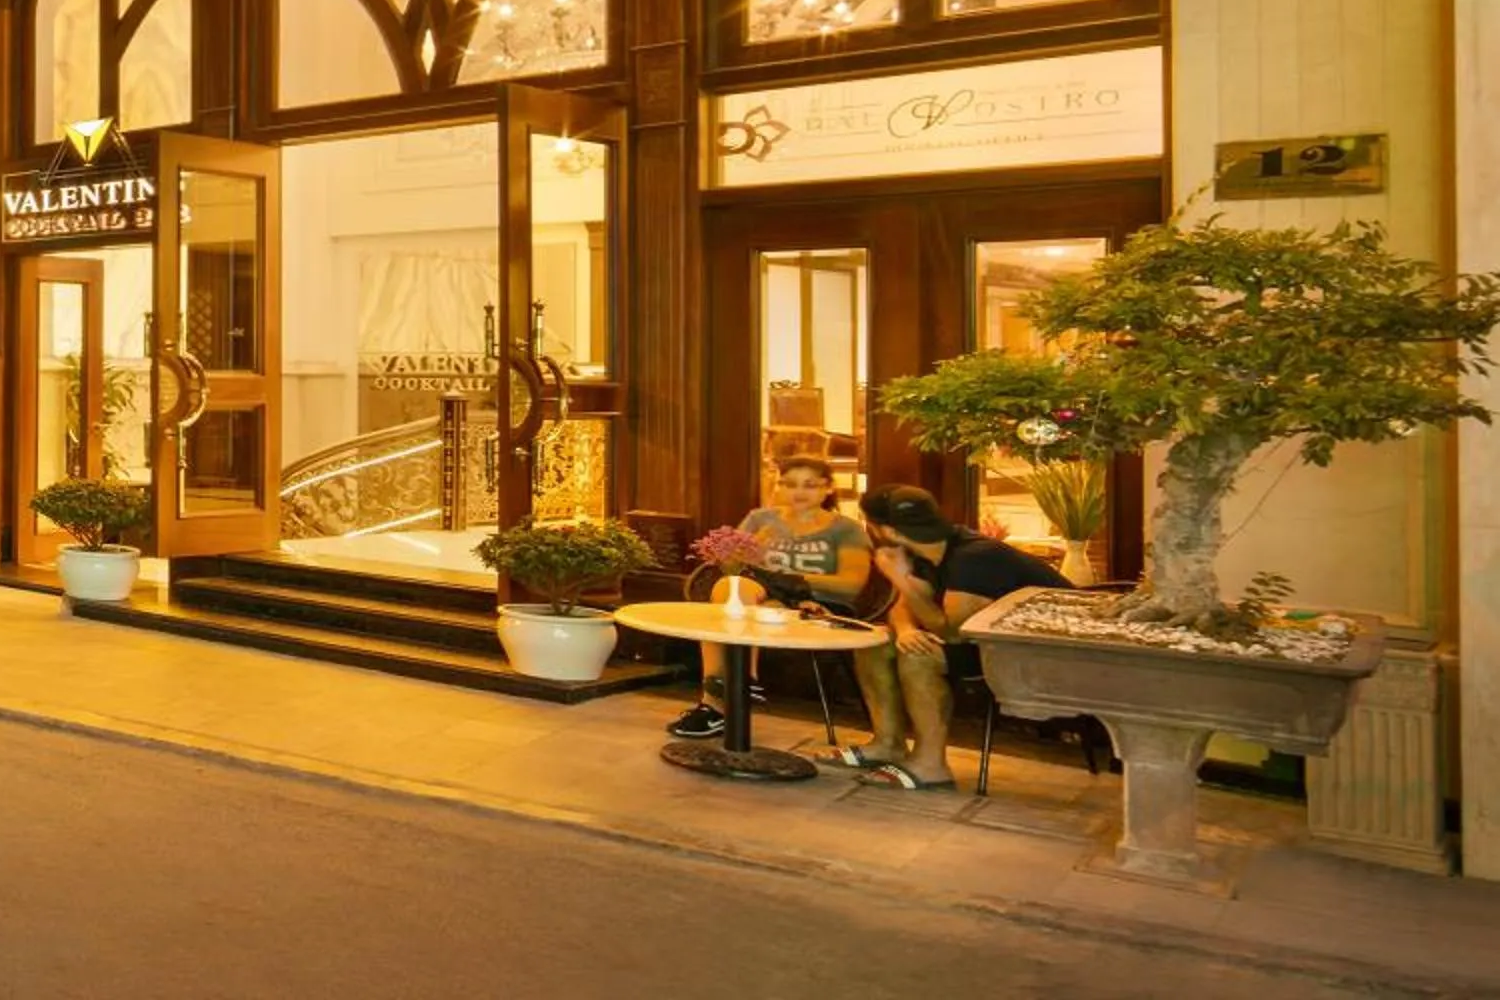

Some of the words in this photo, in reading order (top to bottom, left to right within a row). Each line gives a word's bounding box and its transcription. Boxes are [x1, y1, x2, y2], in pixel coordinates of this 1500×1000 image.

[1251, 144, 1347, 178] 12
[2, 176, 156, 216] VALENTIN
[372, 377, 491, 392] COCKTAIL
